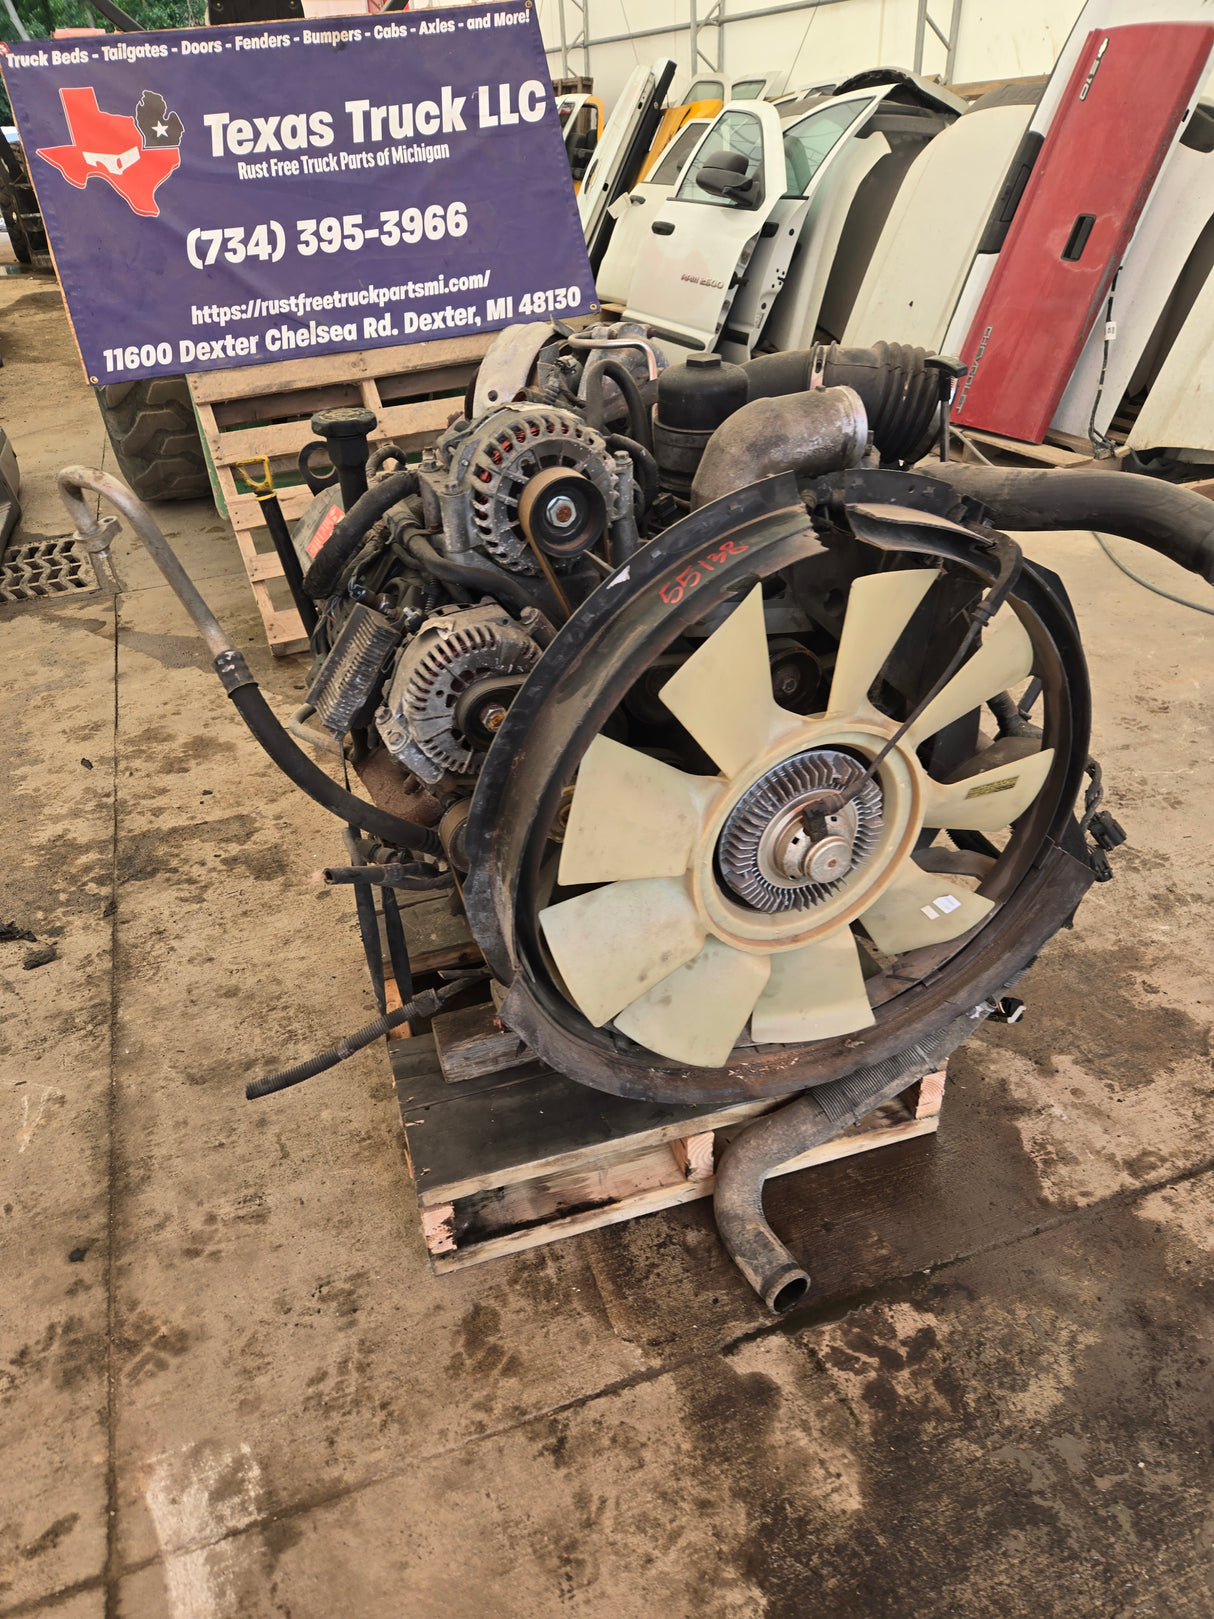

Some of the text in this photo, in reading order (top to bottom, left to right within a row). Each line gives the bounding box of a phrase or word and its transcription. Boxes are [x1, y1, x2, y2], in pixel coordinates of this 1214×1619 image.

[6, 50, 49, 68] Truck
[51, 47, 89, 65] Beds
[101, 43, 168, 63] Tailgates
[181, 40, 222, 55] Doors
[235, 32, 290, 51] Fenders
[303, 28, 362, 46] Bumpers
[374, 23, 407, 39] Cabs
[419, 18, 455, 35] Axles
[467, 13, 491, 30] and
[494, 9, 530, 27] More!
[203, 80, 547, 157] Texas Truck LLC
[238, 143, 450, 180] Rust Free Truck Parts of Michigan
[187, 202, 468, 269] (734) 395-3966
[103, 286, 581, 372] 11600 Dexter Chelsea Rd. Dexter, MI 48130
[191, 270, 491, 326] https://rustfreetruckpartsmi.com/
[955, 326, 993, 414] CHEVROLET
[659, 541, 749, 604] 55138
